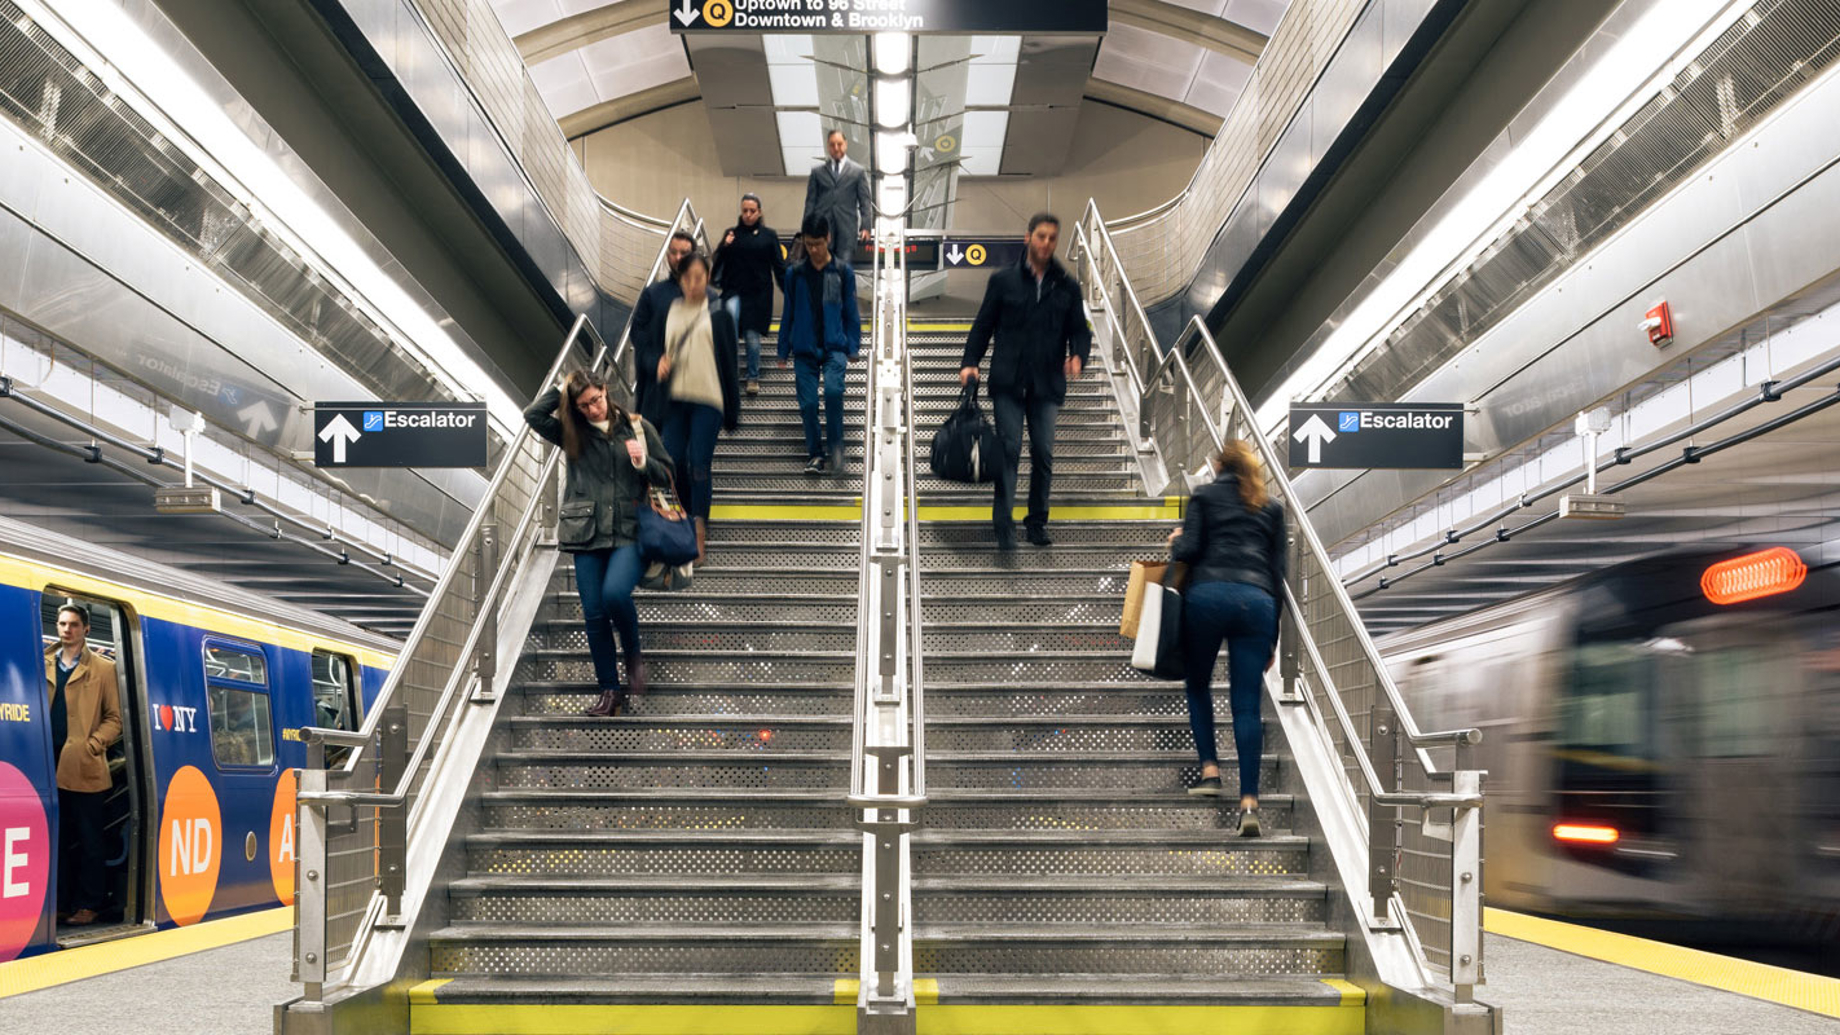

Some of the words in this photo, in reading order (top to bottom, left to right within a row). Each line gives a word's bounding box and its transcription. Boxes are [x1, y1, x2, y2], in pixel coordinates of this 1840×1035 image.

[709, 3, 726, 21] Q
[735, 0, 801, 12] Uptown
[806, 0, 824, 10] to
[828, 0, 849, 10] 96
[853, 0, 906, 10] Street
[734, 12, 827, 27] Downtown
[831, 12, 844, 27] &
[848, 12, 923, 30] Brooklyn
[971, 248, 982, 261] Q
[384, 411, 476, 428] Escalator
[1360, 412, 1453, 429] Escalator
[172, 705, 197, 733] NY
[278, 813, 296, 863] A
[171, 818, 212, 877] ND
[3, 827, 30, 898] E
